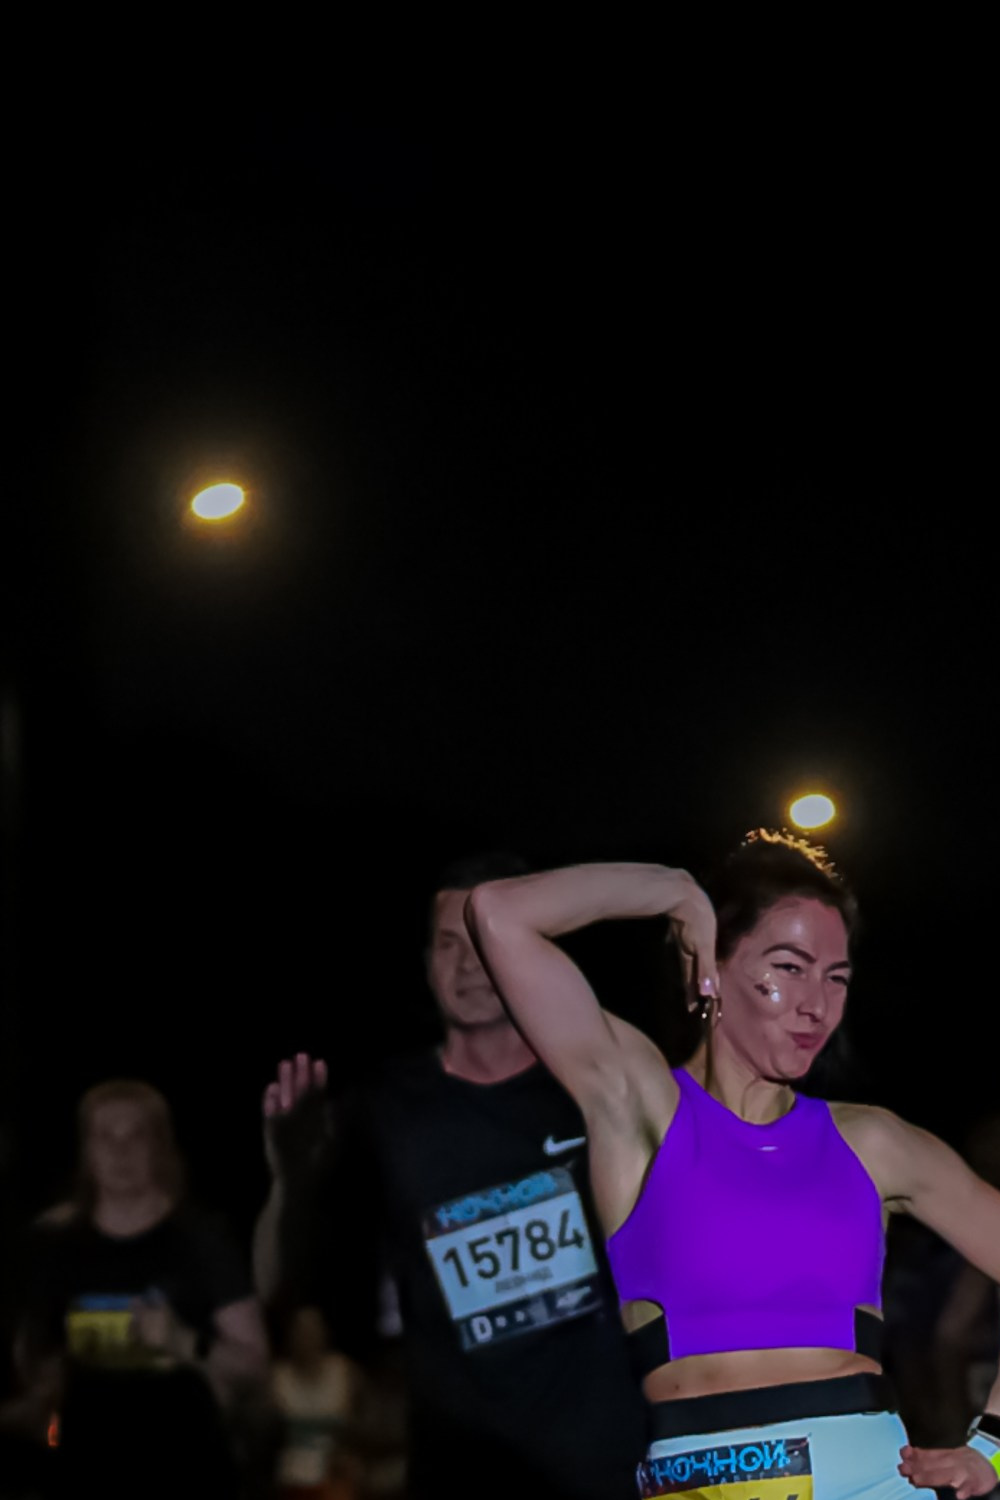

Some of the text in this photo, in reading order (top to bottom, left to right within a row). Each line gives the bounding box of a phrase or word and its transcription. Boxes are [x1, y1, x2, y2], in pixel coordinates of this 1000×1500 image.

[443, 1210, 584, 1287] 15784
[471, 1315, 493, 1343] D
[652, 1440, 790, 1487] НОЧНОЙ
